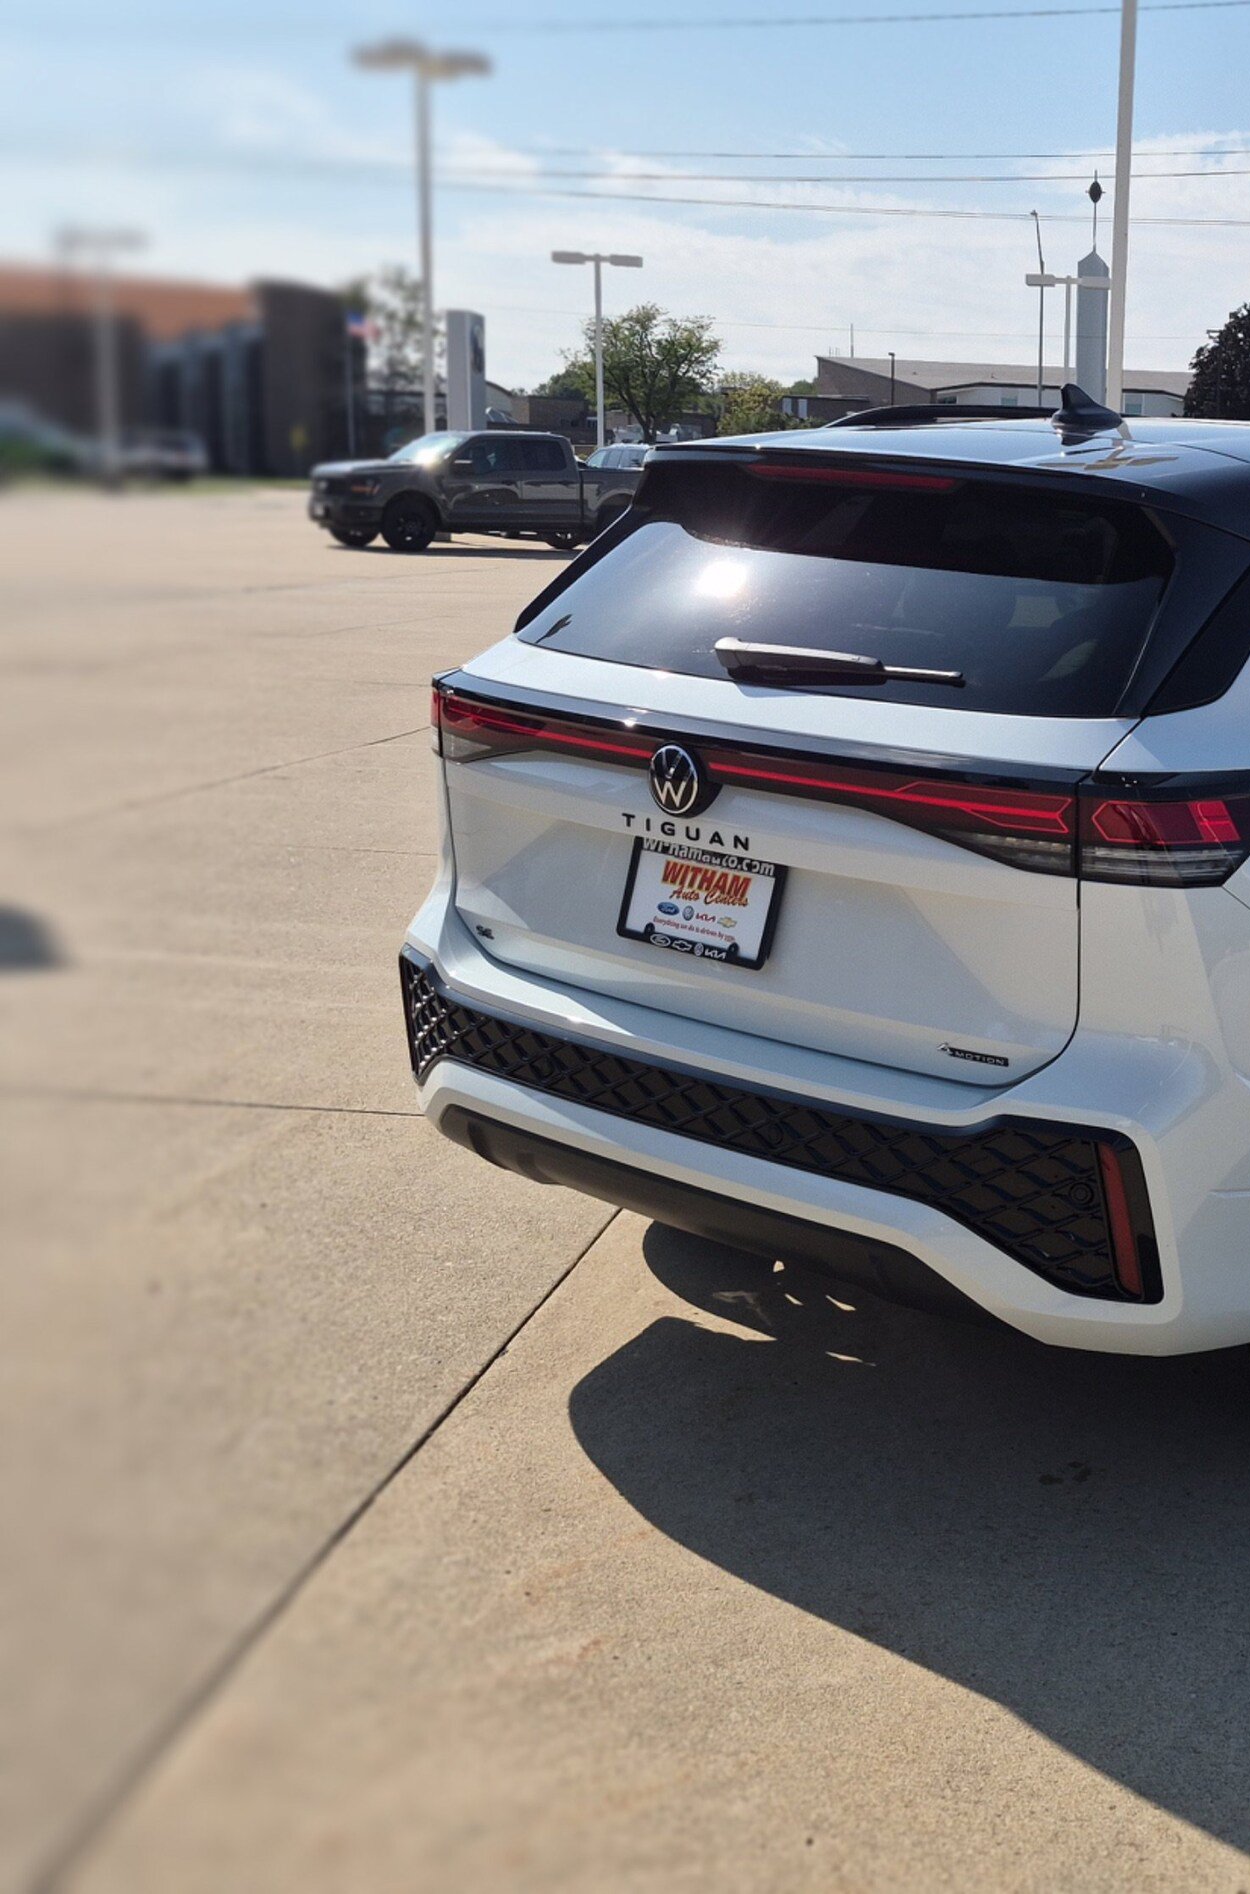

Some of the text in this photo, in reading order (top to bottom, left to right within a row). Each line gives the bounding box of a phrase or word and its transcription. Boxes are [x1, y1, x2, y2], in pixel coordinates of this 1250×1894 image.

[622, 813, 749, 851] TIGUAN
[661, 859, 753, 899] WITHAM
[668, 885, 749, 907] Auto Centers
[937, 1042, 1005, 1066] 4MOTION
